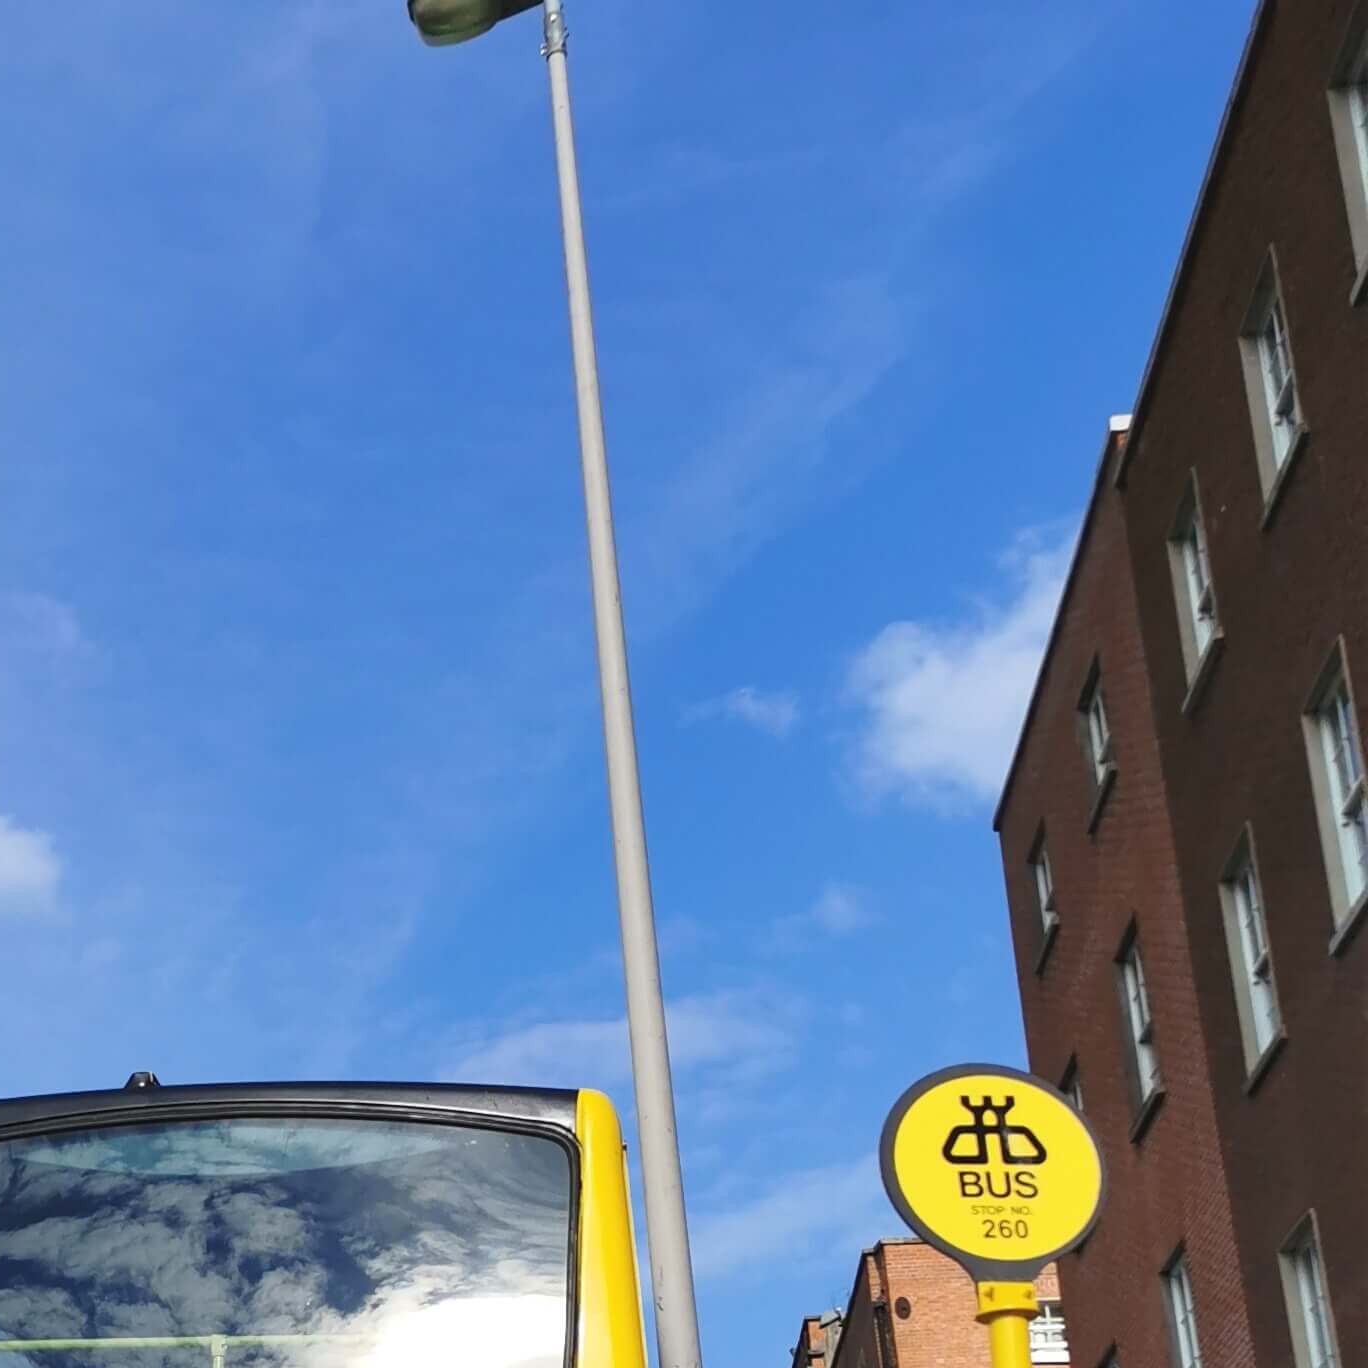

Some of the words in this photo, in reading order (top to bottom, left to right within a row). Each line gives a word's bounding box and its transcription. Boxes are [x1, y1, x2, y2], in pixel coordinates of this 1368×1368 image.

[958, 1171, 1039, 1199] BUS
[971, 1205, 1004, 1215] STOP
[982, 1219, 1029, 1239] 260
